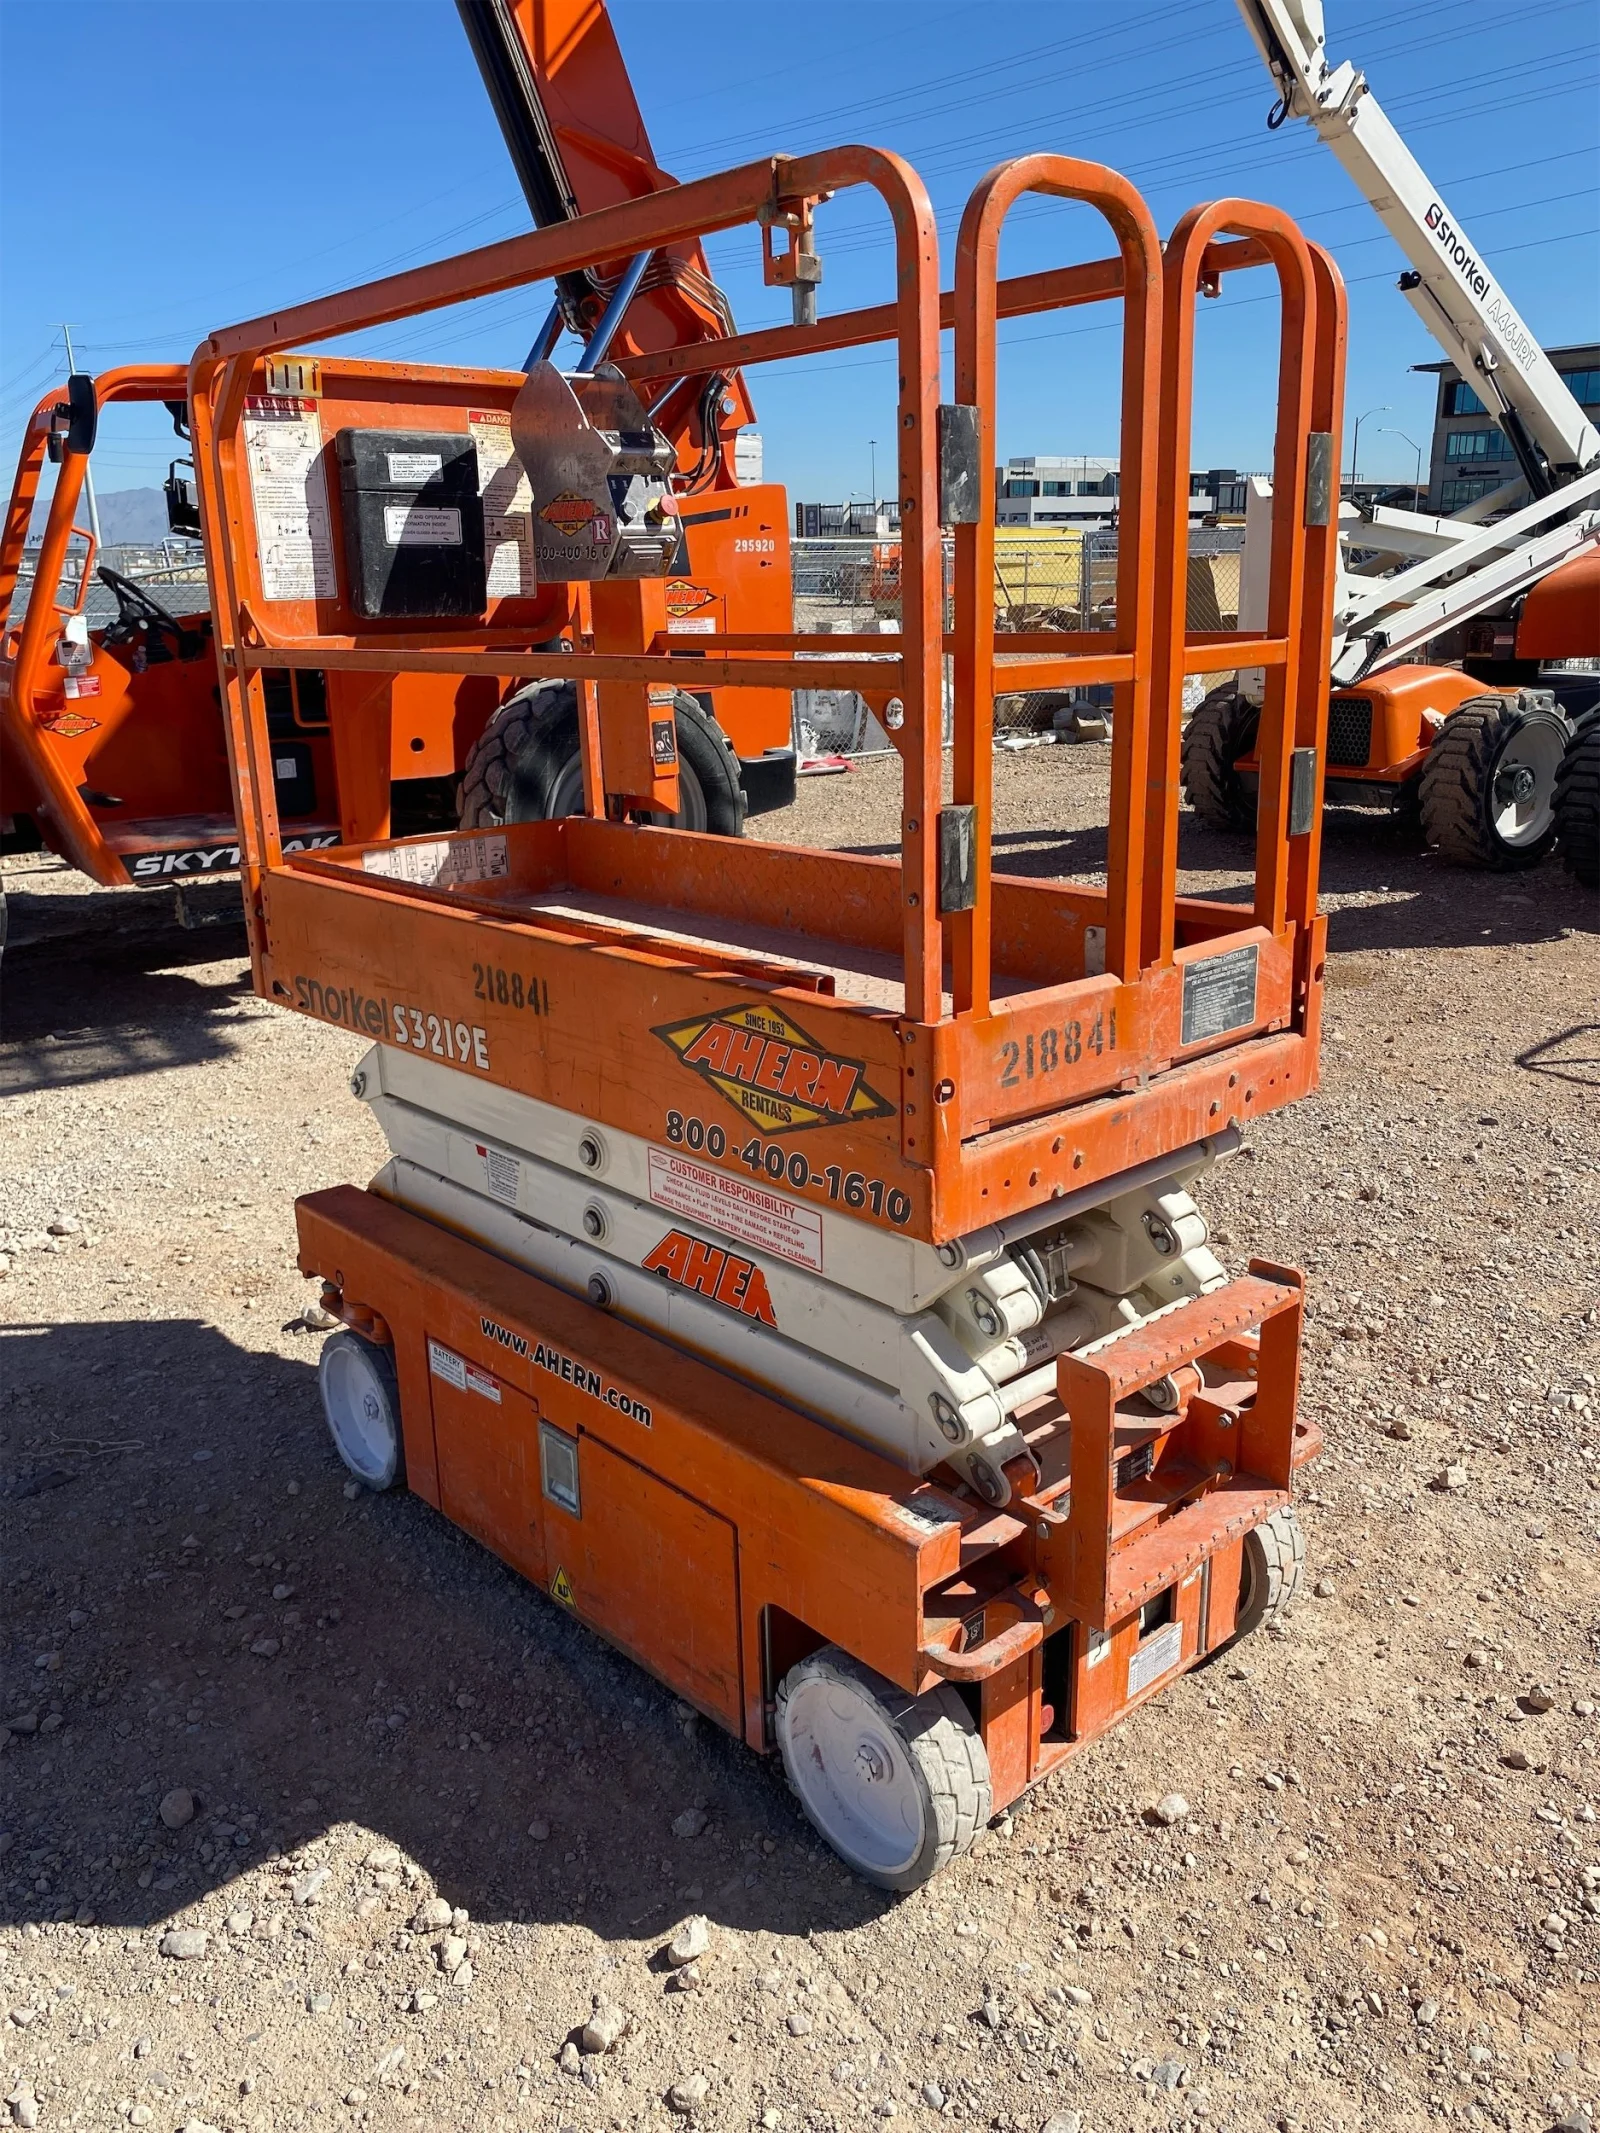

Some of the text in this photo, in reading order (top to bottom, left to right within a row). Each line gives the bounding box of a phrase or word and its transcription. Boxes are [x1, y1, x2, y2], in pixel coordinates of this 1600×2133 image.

[1437, 221, 1538, 370] snorkel A46JRT
[486, 415, 511, 425] DANG
[594, 520, 609, 540] R
[735, 539, 775, 552] 295920
[133, 835, 339, 877] SKYTAK
[472, 963, 549, 1016] 218841
[295, 975, 491, 1071] snorkel S3219E
[745, 1012, 785, 1036] SINCE 1953
[1000, 1007, 1116, 1088] 218841
[683, 1022, 859, 1114] AHERN
[741, 1089, 792, 1123] RENTALS
[665, 1109, 912, 1225] 800-400-1610
[670, 1159, 795, 1219] CUSTOMER RESPONSIBILITY
[653, 1191, 816, 1266] DAMAGE TO EQUIPMENT BATTERY MAINTENANCE CLEANING
[663, 1184, 805, 1249] INSURANCE FLAT TIRES TIRE DAMAGE REFUELING
[666, 1175, 800, 1235] CHECK ALL FLUID LEVELS DAILY BEFORE START-UP
[433, 1346, 460, 1369] BATTERY
[479, 1316, 652, 1428] www.AHERN.com
